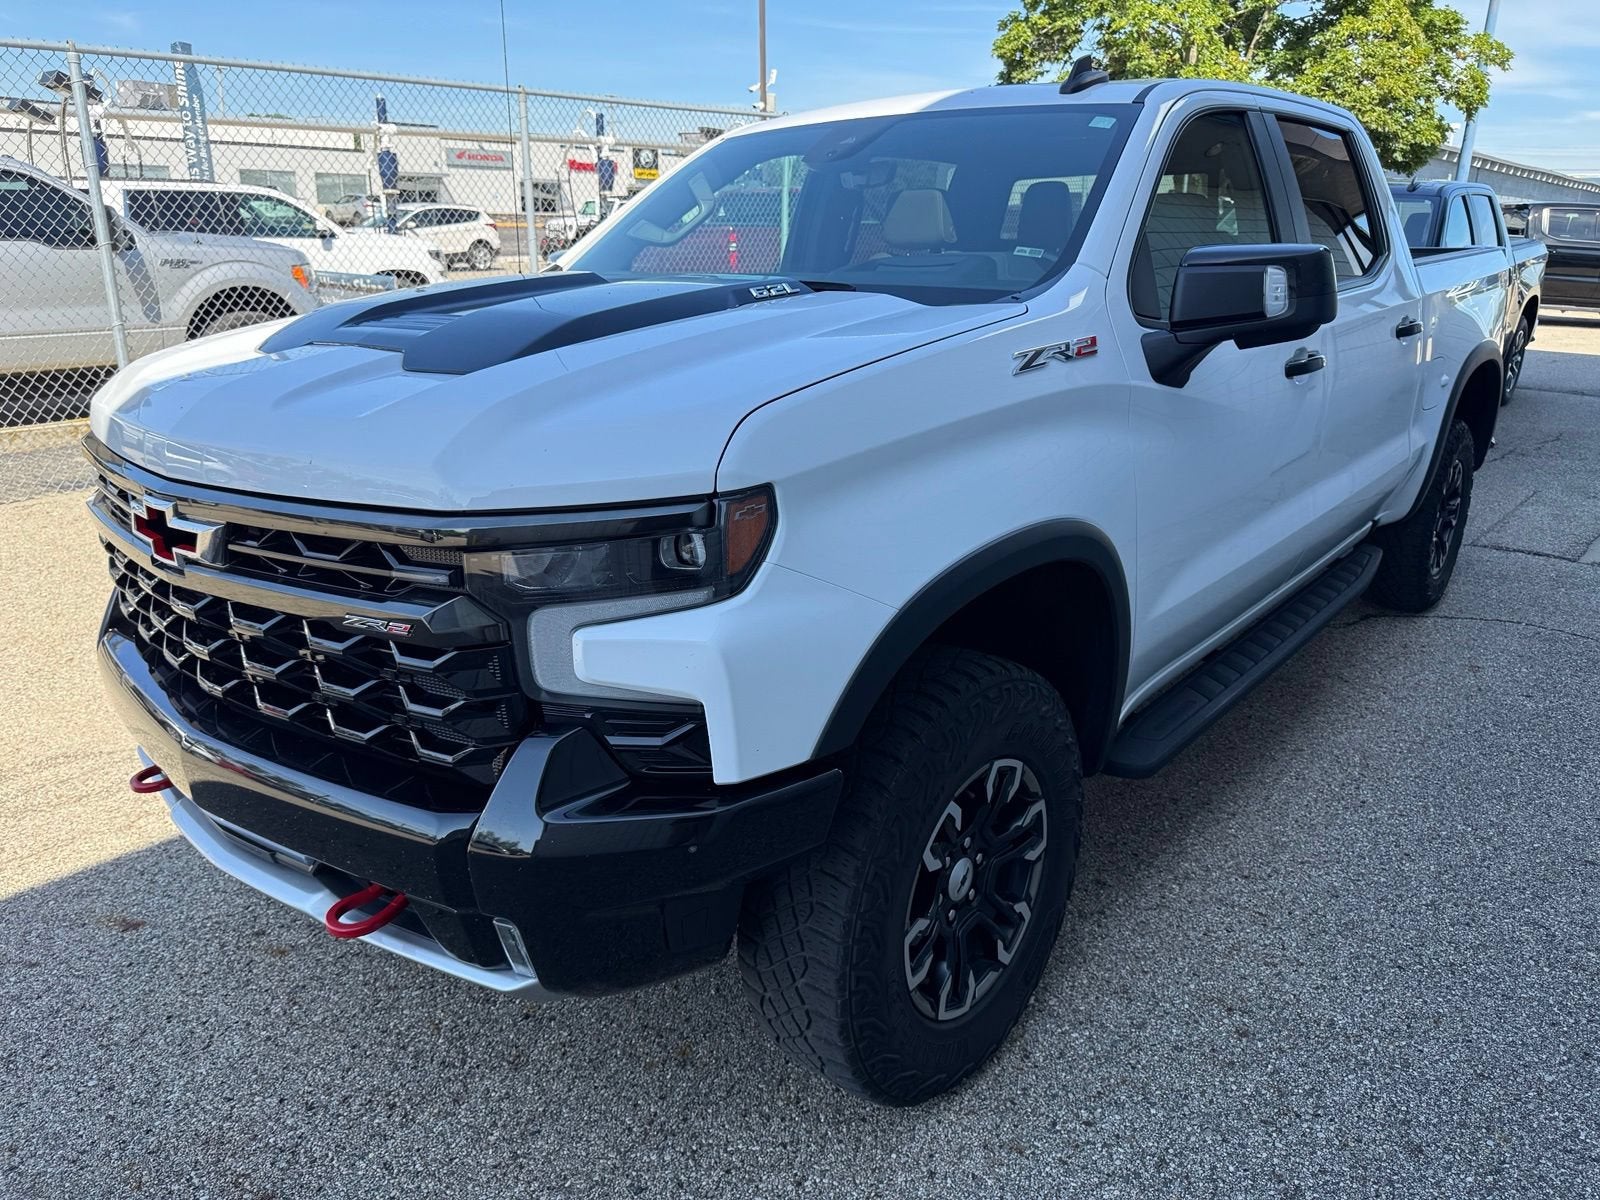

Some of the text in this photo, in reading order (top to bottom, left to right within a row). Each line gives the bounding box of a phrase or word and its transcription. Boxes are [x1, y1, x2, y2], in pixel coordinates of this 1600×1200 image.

[174, 61, 190, 108] Shine
[182, 110, 192, 127] to
[184, 131, 197, 164] Way
[467, 153, 505, 162] HONDA
[1012, 335, 1098, 376] ZR2
[343, 615, 412, 635] ZR2
